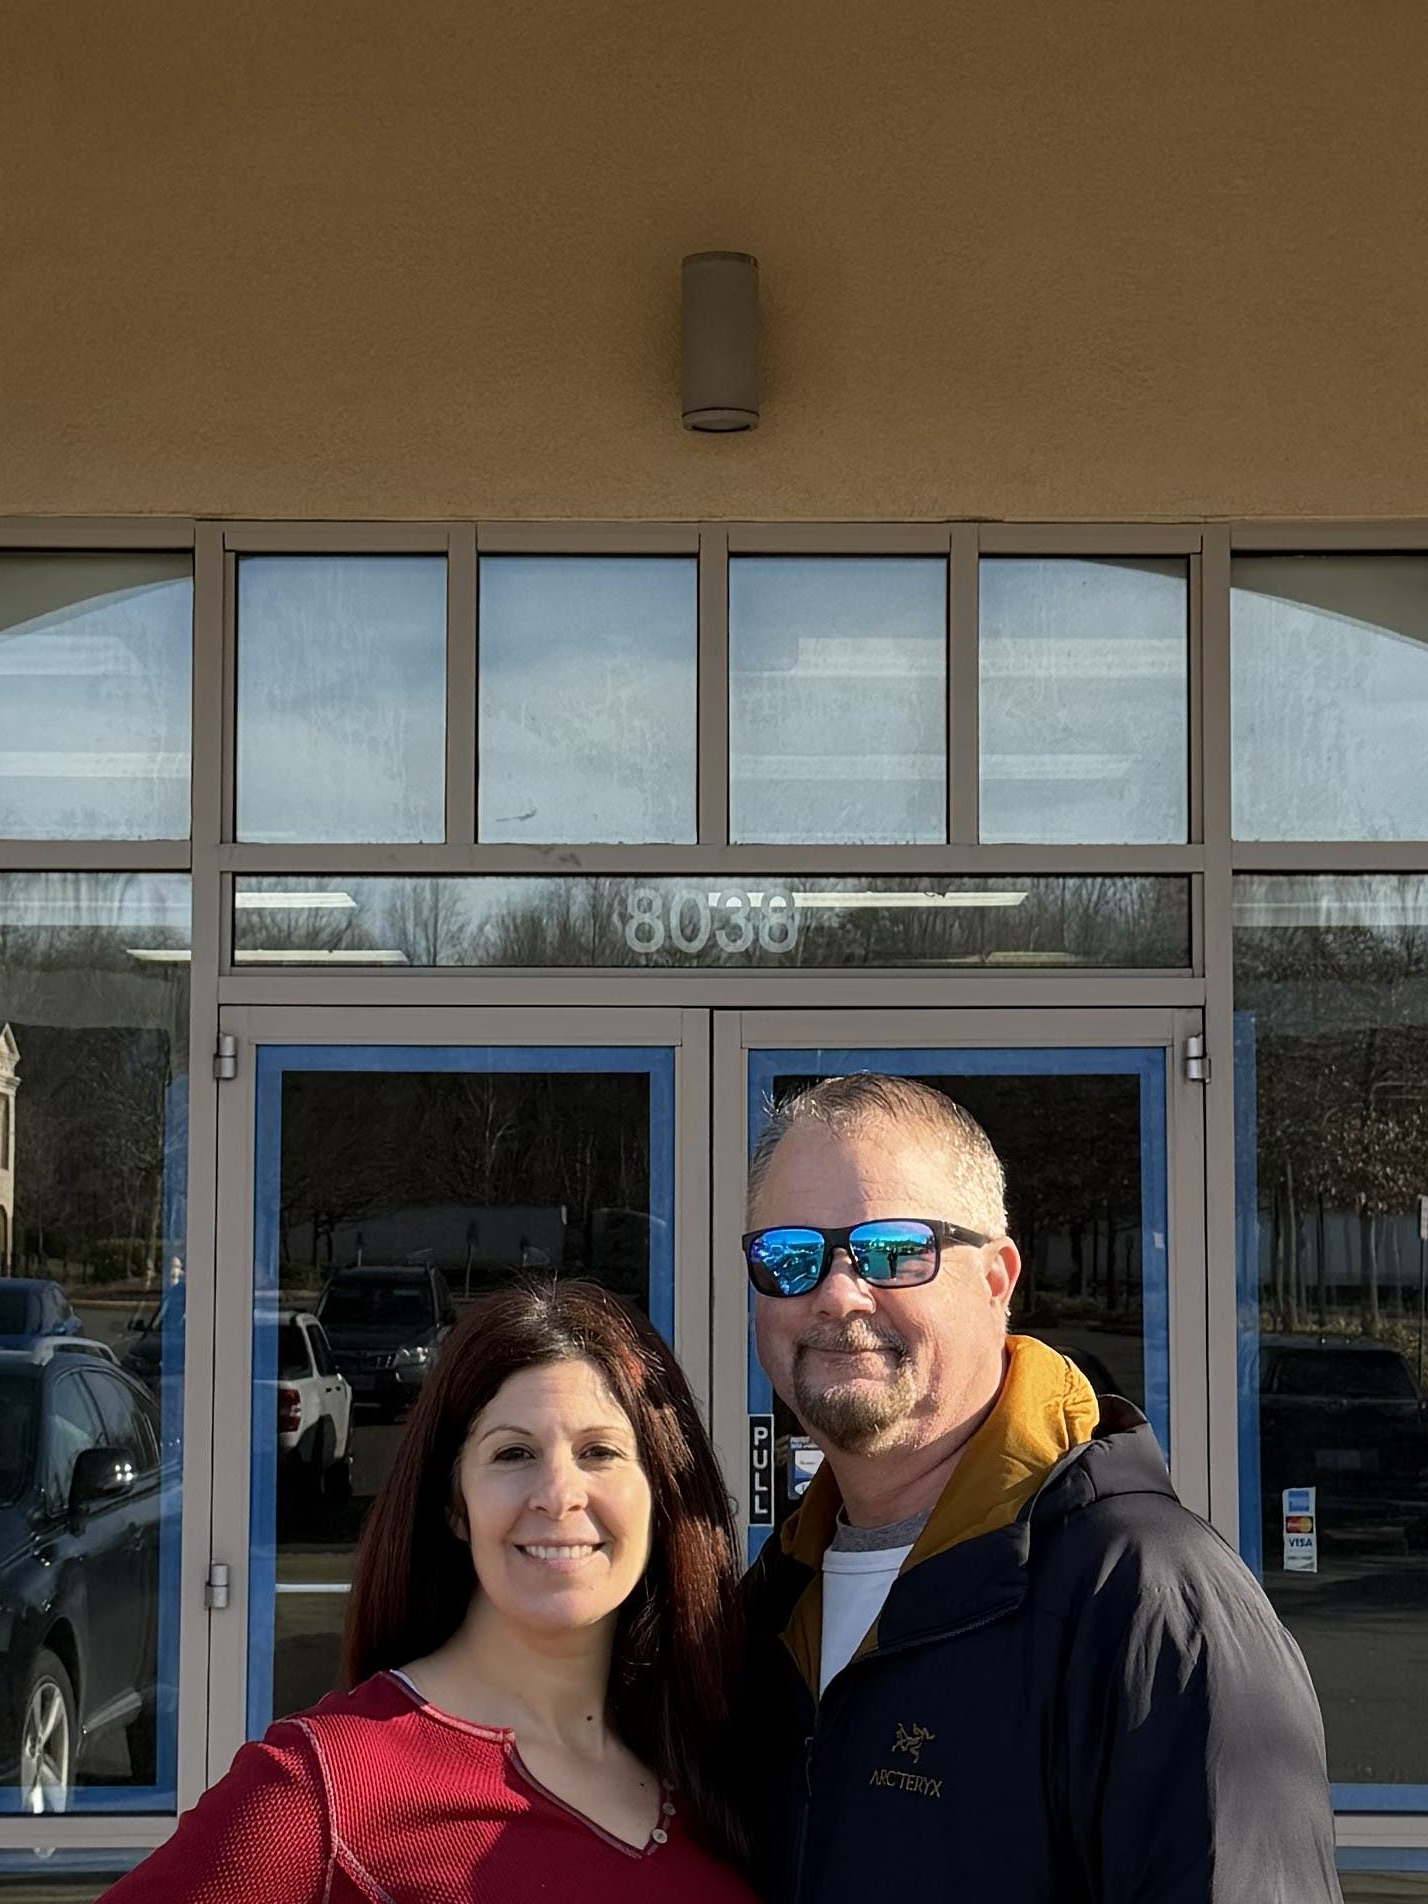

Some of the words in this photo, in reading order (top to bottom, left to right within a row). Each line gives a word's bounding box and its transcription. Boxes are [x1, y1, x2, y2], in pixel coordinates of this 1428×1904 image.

[624, 887, 798, 954] 8038
[753, 1426, 769, 1515] PULL
[1288, 1538, 1312, 1548] VISA
